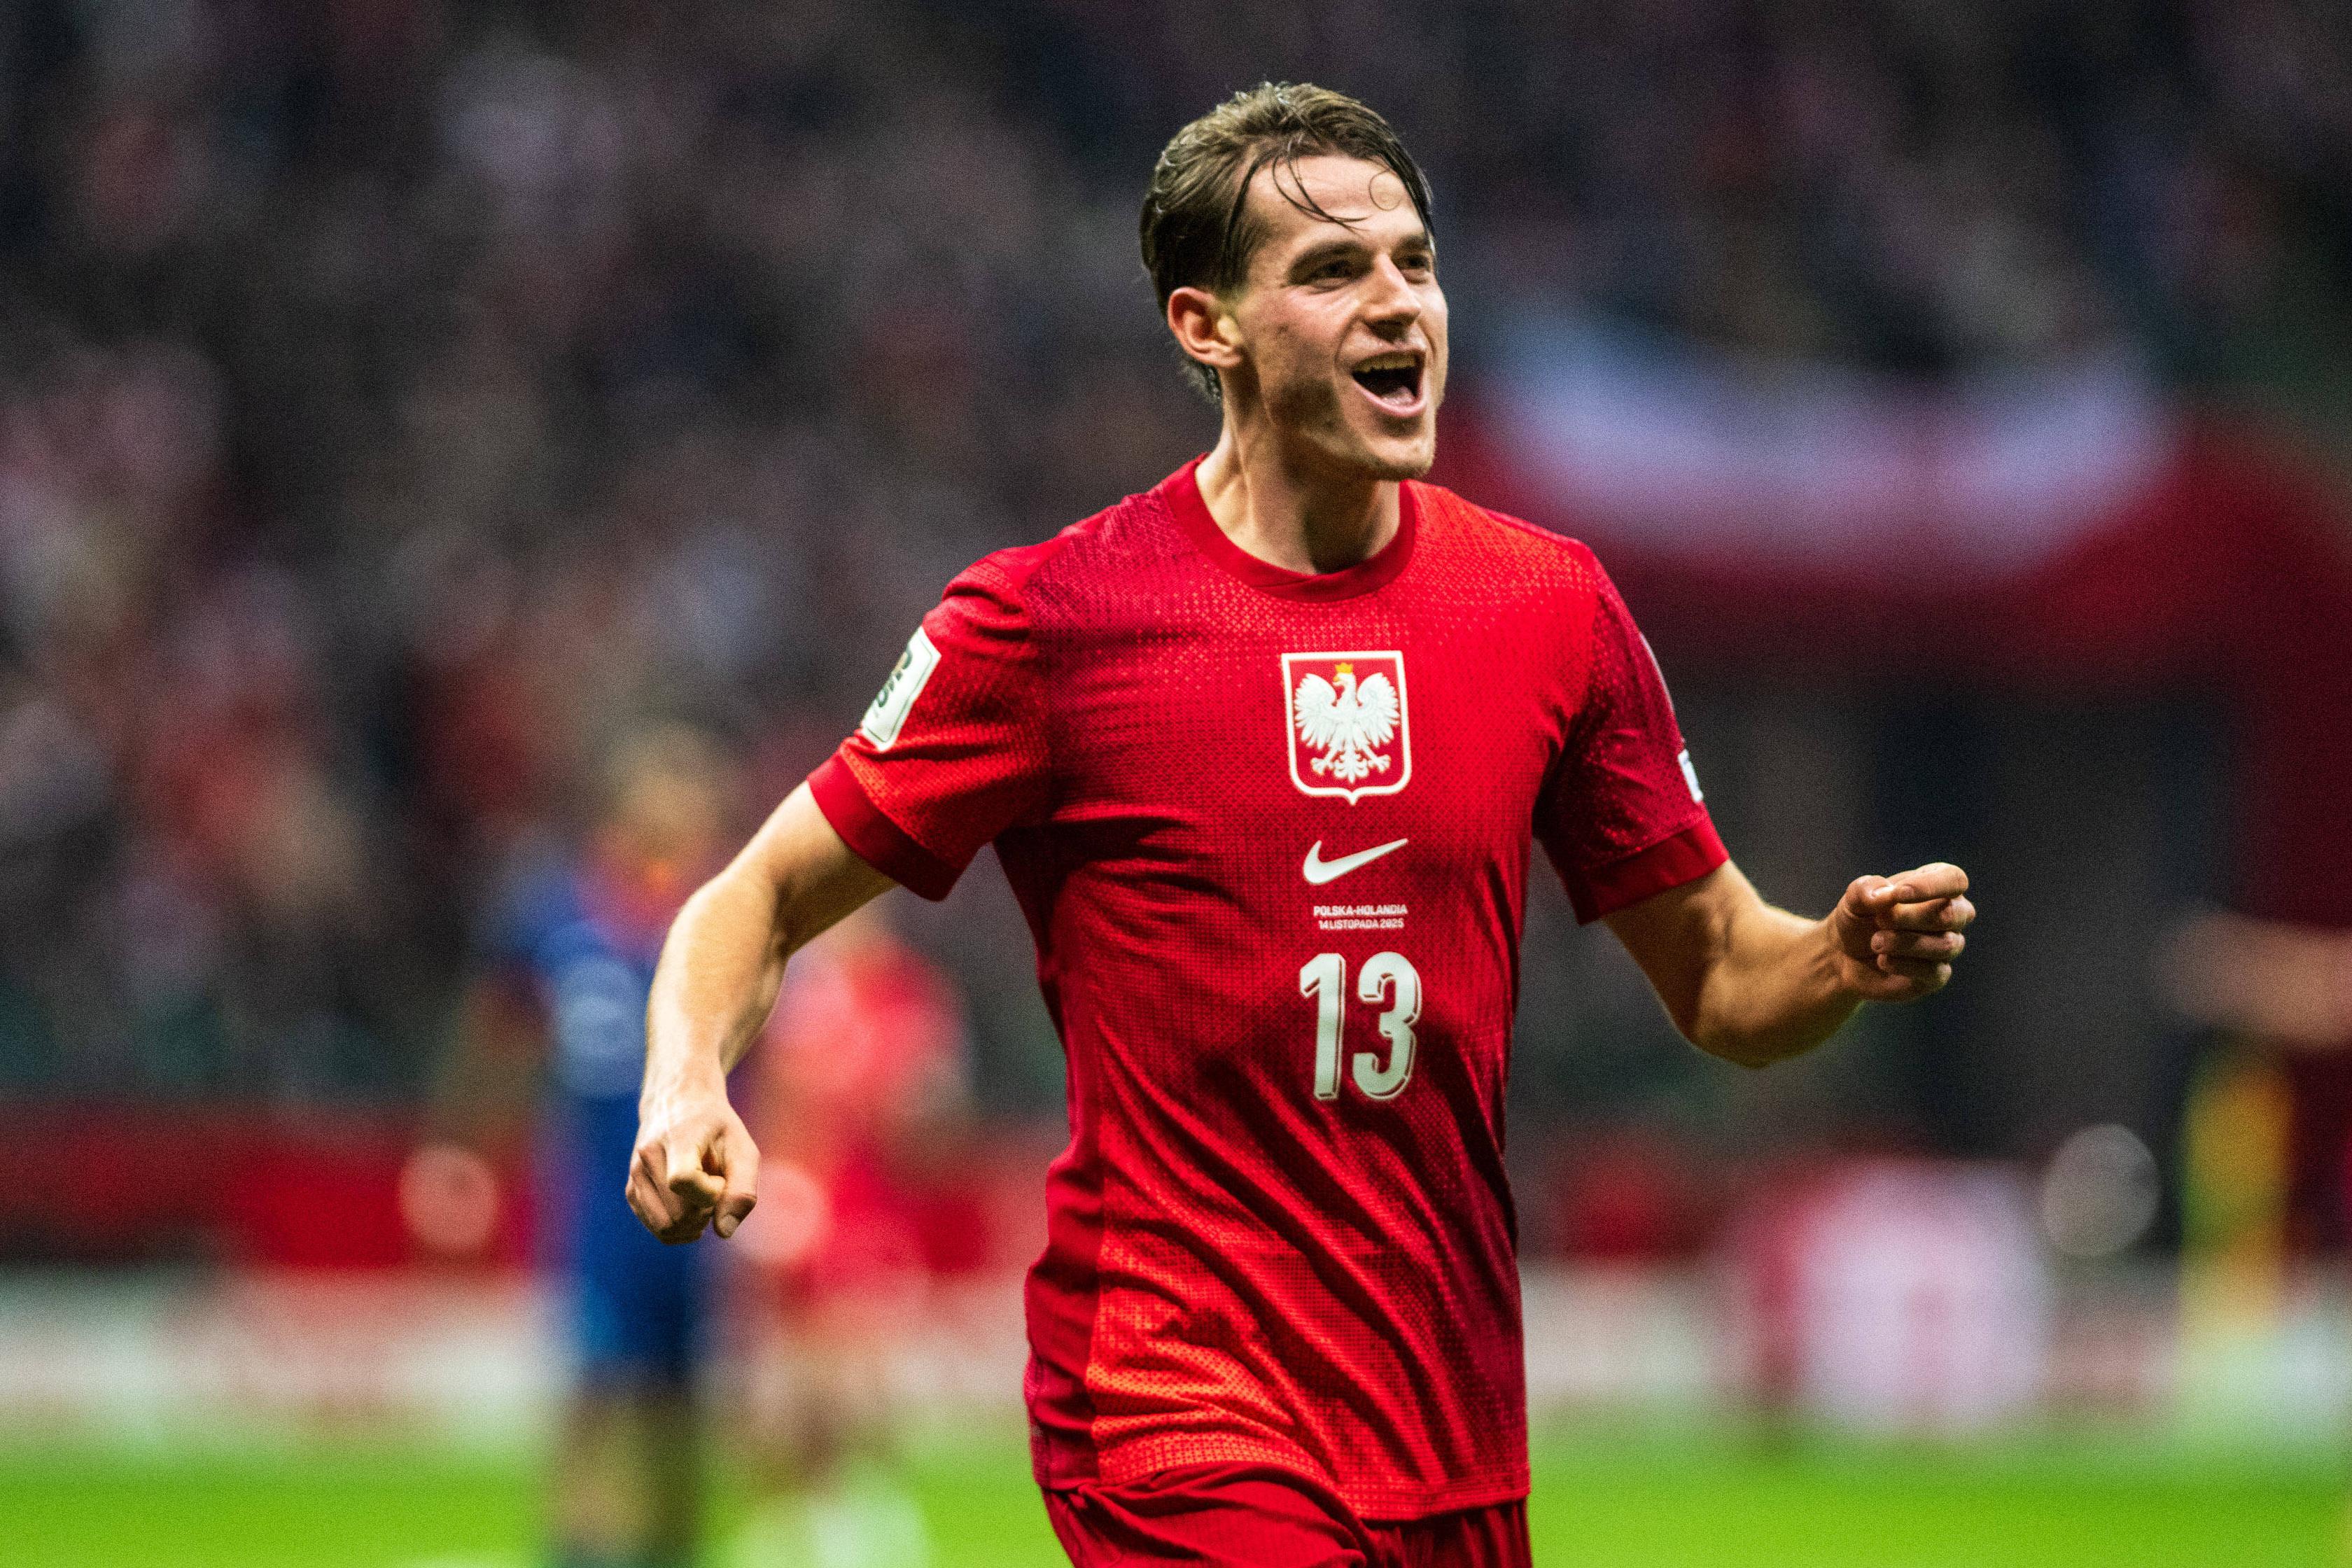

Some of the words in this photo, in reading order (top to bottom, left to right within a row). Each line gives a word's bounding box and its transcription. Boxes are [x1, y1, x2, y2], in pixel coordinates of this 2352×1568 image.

[1319, 920, 1329, 930] 14
[1330, 918, 1379, 930] LISTOPADA
[1380, 918, 1404, 929] 2025
[1300, 951, 1422, 1100] 13
